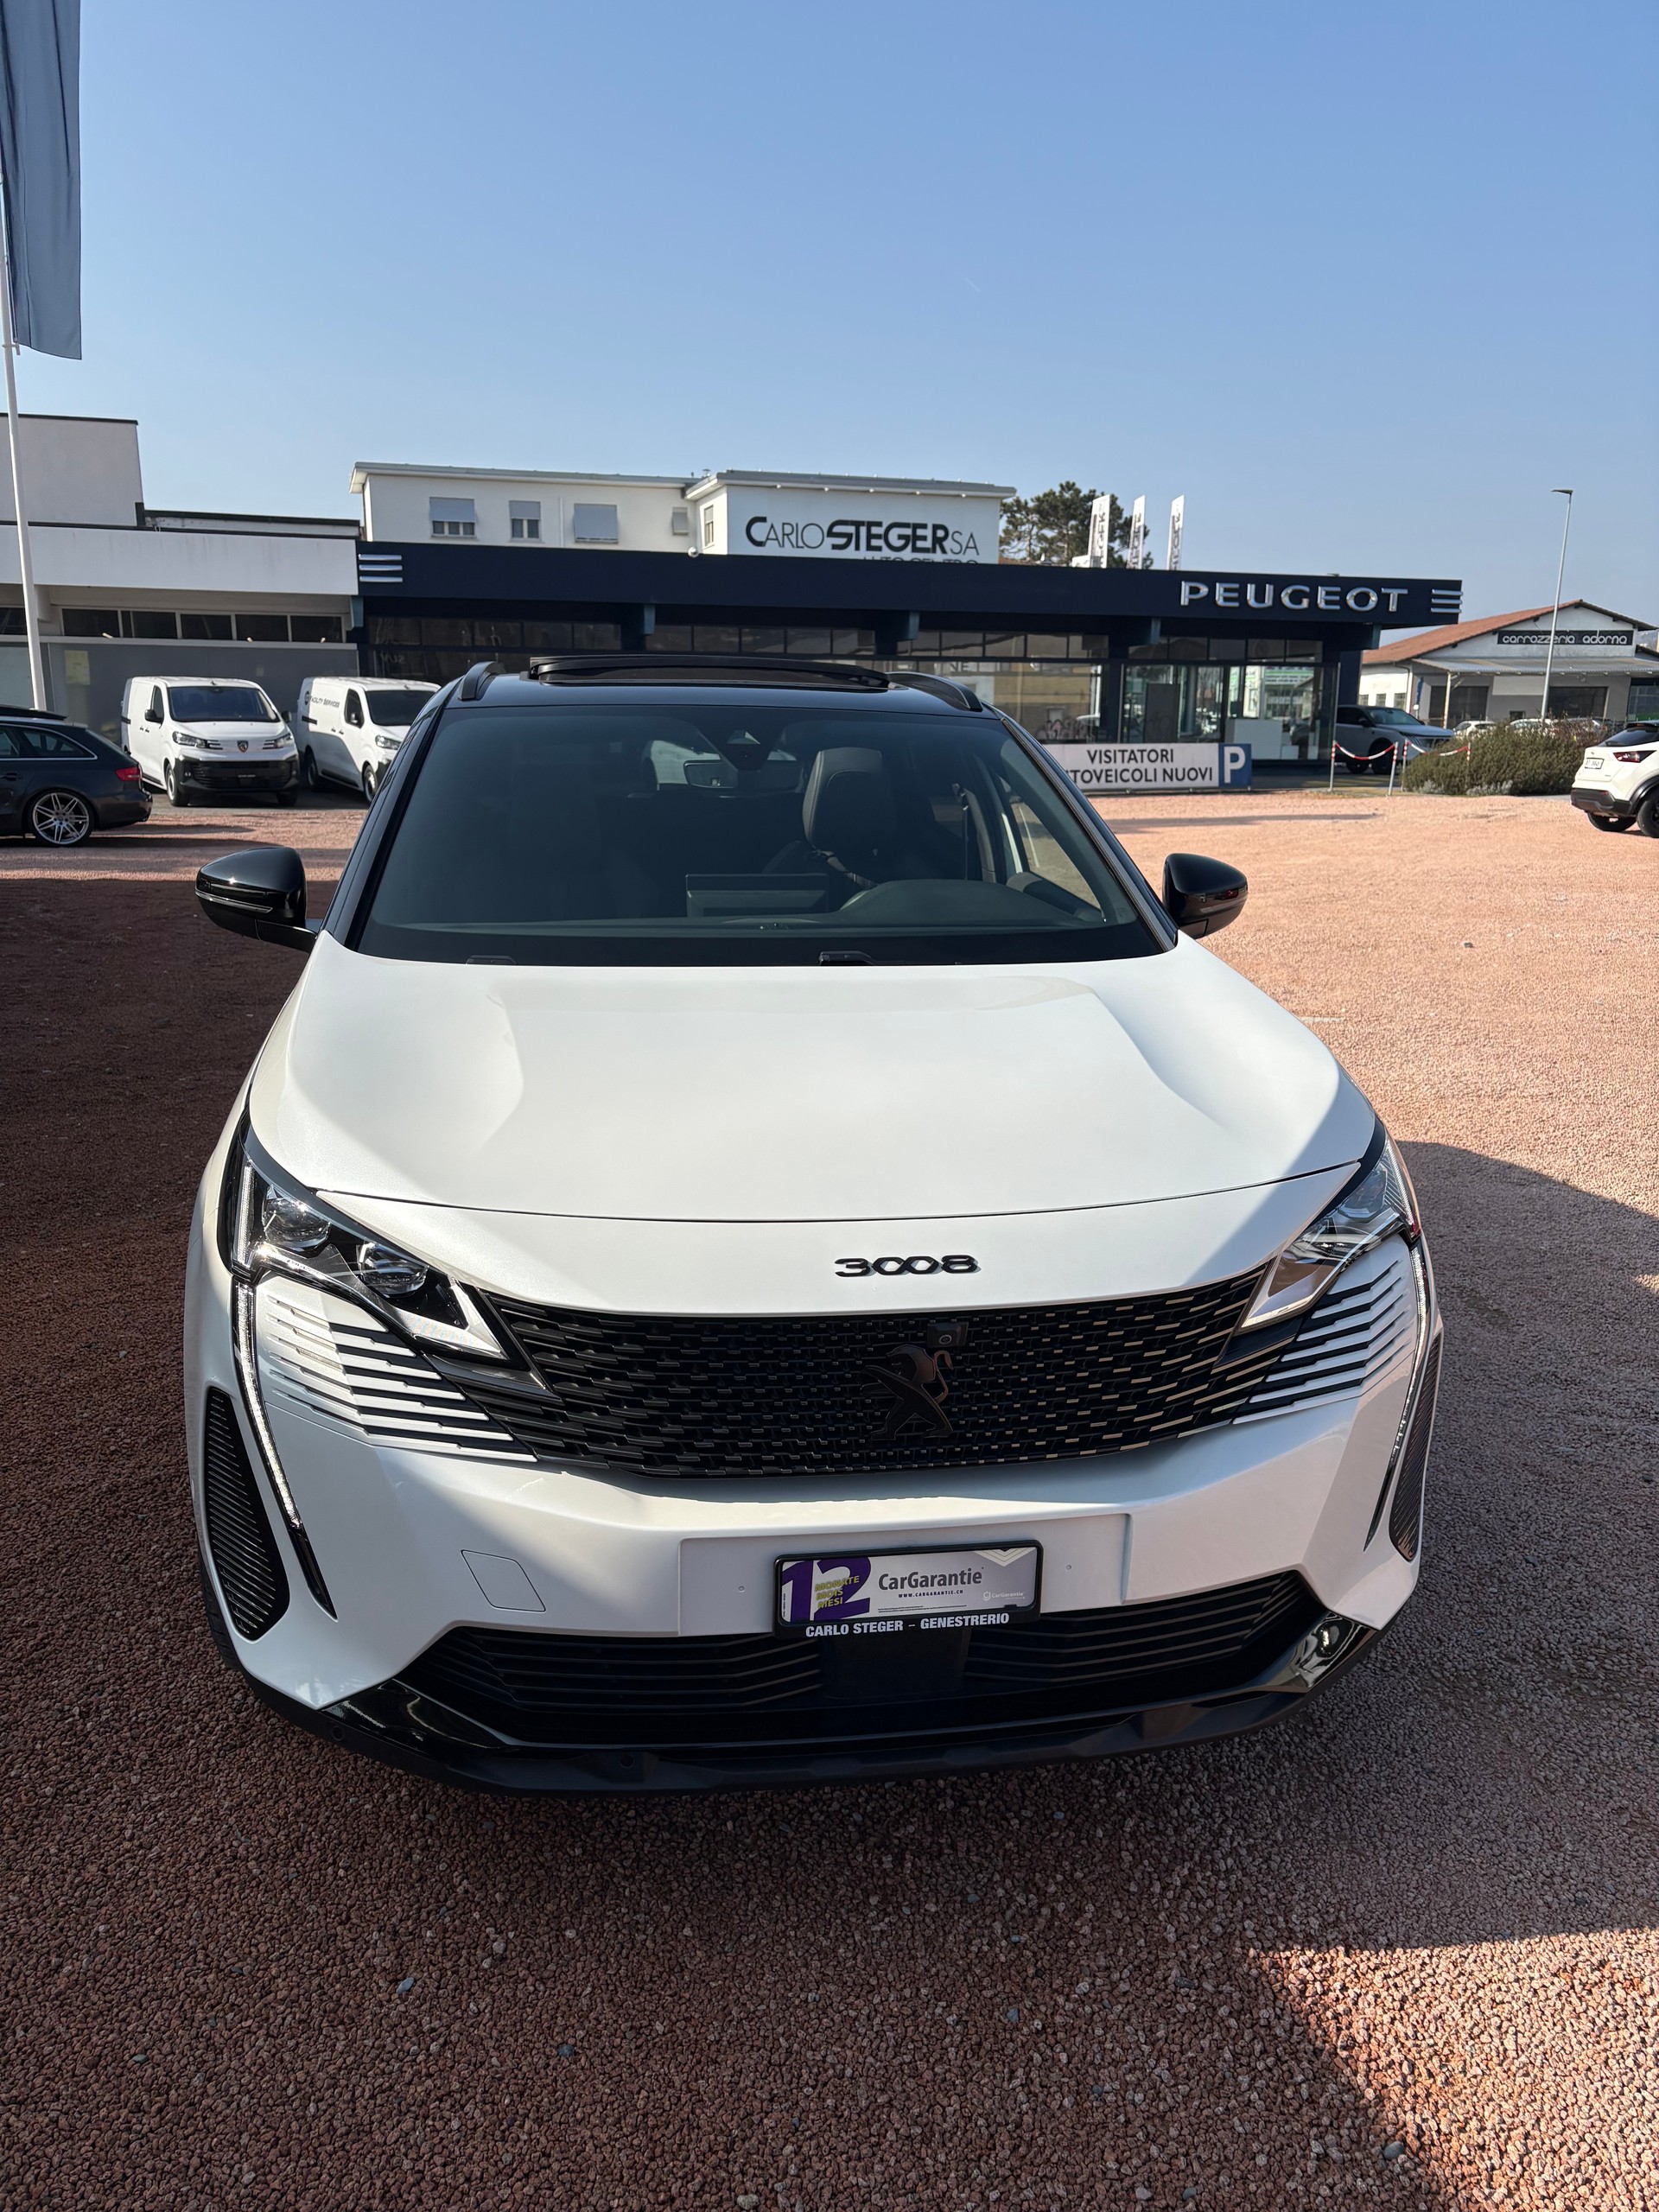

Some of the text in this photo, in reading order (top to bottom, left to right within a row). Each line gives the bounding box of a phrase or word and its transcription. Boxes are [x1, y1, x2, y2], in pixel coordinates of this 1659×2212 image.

[746, 516, 980, 556] CARLO STEGER SA
[1180, 581, 1408, 613] PEUGEOT
[1502, 630, 1628, 645] carrozzeria adorna
[1087, 748, 1173, 764] VISITATORI
[1224, 747, 1246, 784] P
[1065, 767, 1213, 784] TOVEICOLI NUOVI
[834, 1255, 979, 1277] 3008
[782, 1557, 871, 1621] 12
[815, 1575, 860, 1592] MONATE
[878, 1567, 983, 1591] CarGarantie
[817, 1587, 843, 1601] MOIS
[817, 1596, 843, 1609] MESI
[805, 1623, 849, 1637] CARLO
[853, 1620, 904, 1634] STEGER
[920, 1612, 1010, 1630] GENESTRERIO
